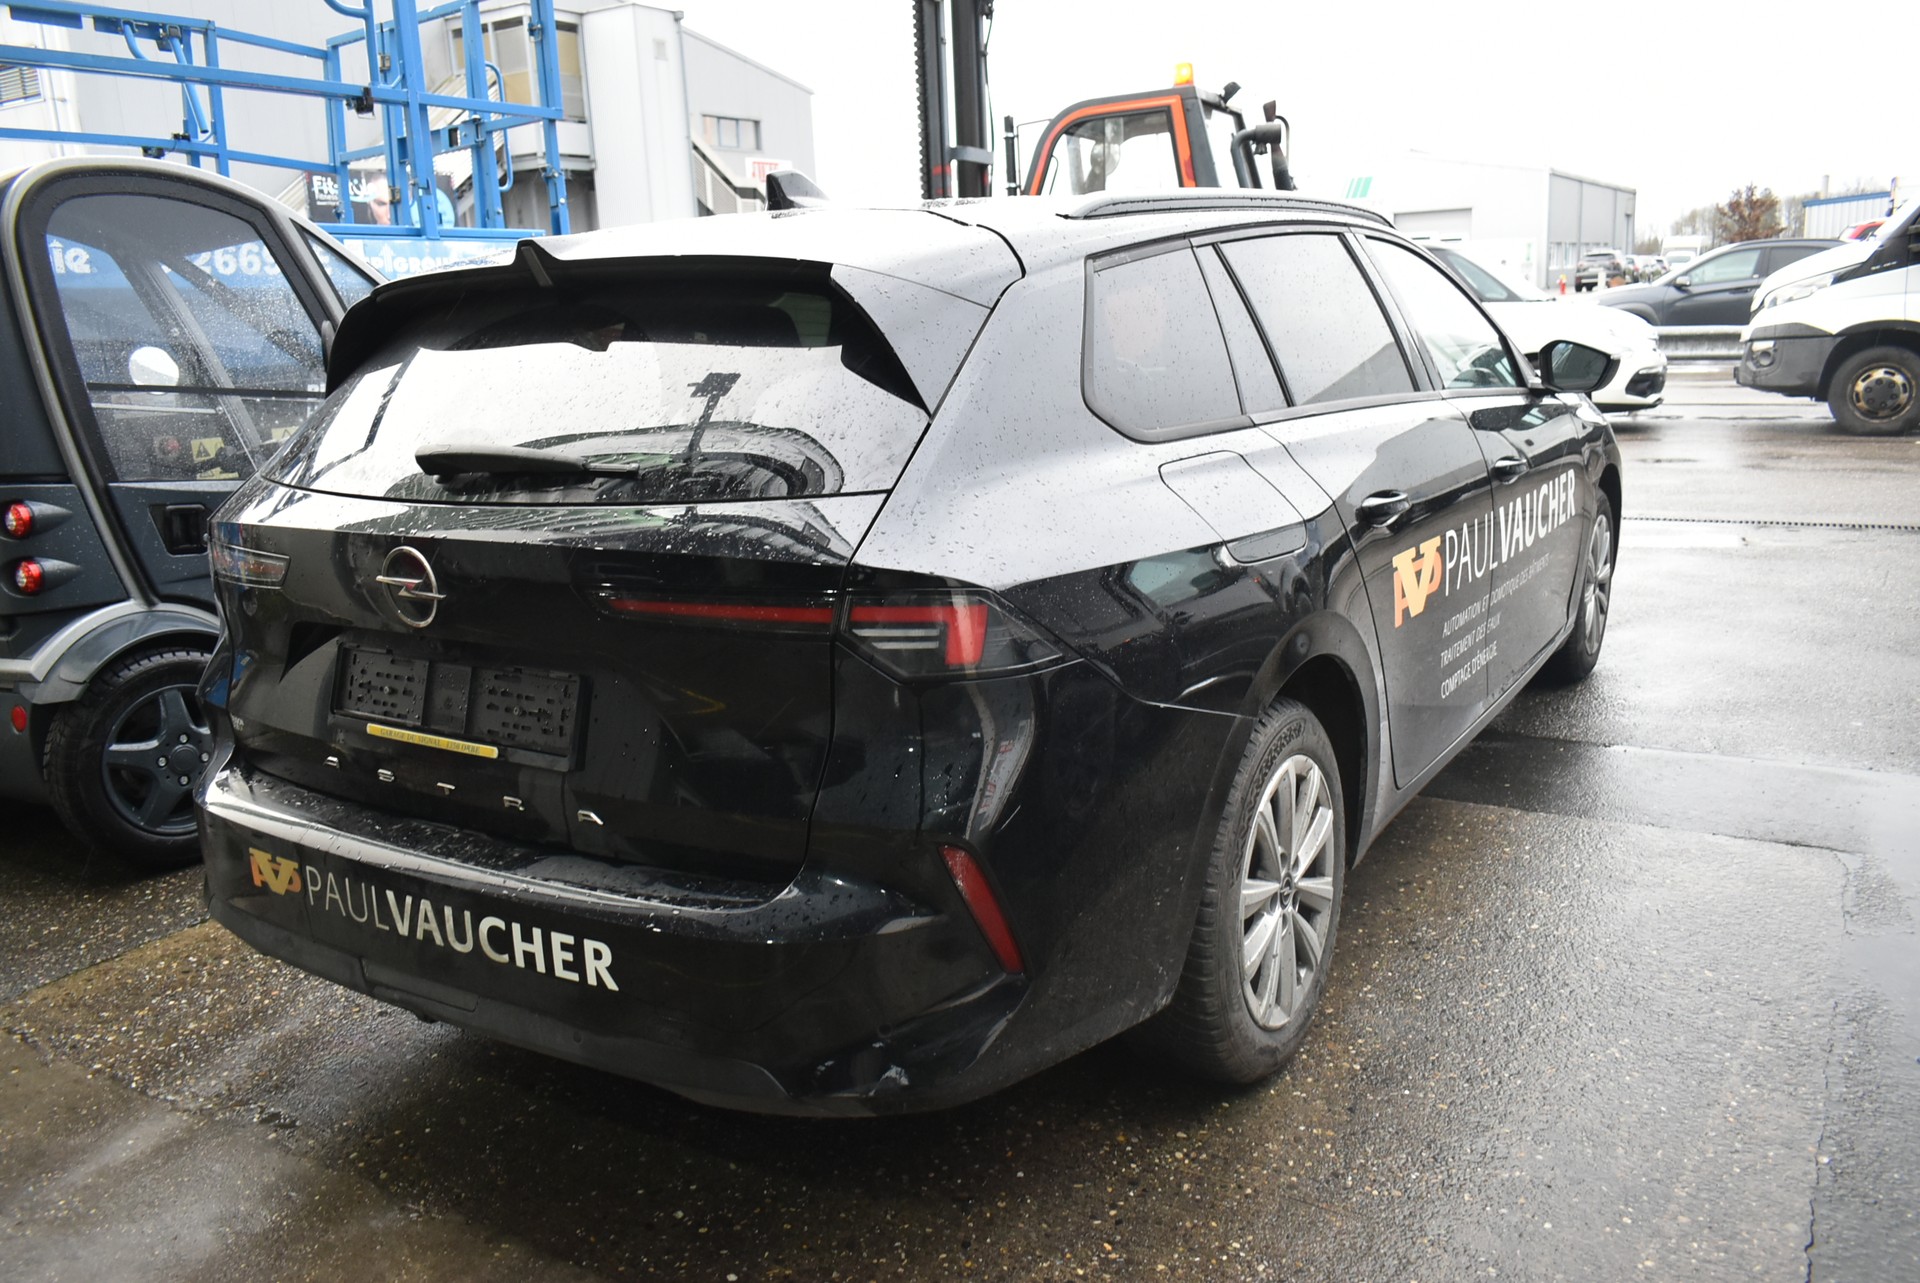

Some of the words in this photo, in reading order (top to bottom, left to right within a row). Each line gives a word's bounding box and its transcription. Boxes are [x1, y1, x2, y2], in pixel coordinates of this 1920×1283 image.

[1442, 600, 1481, 638] AUTOMATION
[1440, 629, 1476, 668] TRAITEMENT
[1440, 661, 1471, 699] COMPTAGE
[380, 728, 406, 741] GARAGE
[323, 756, 603, 825] ASTRA
